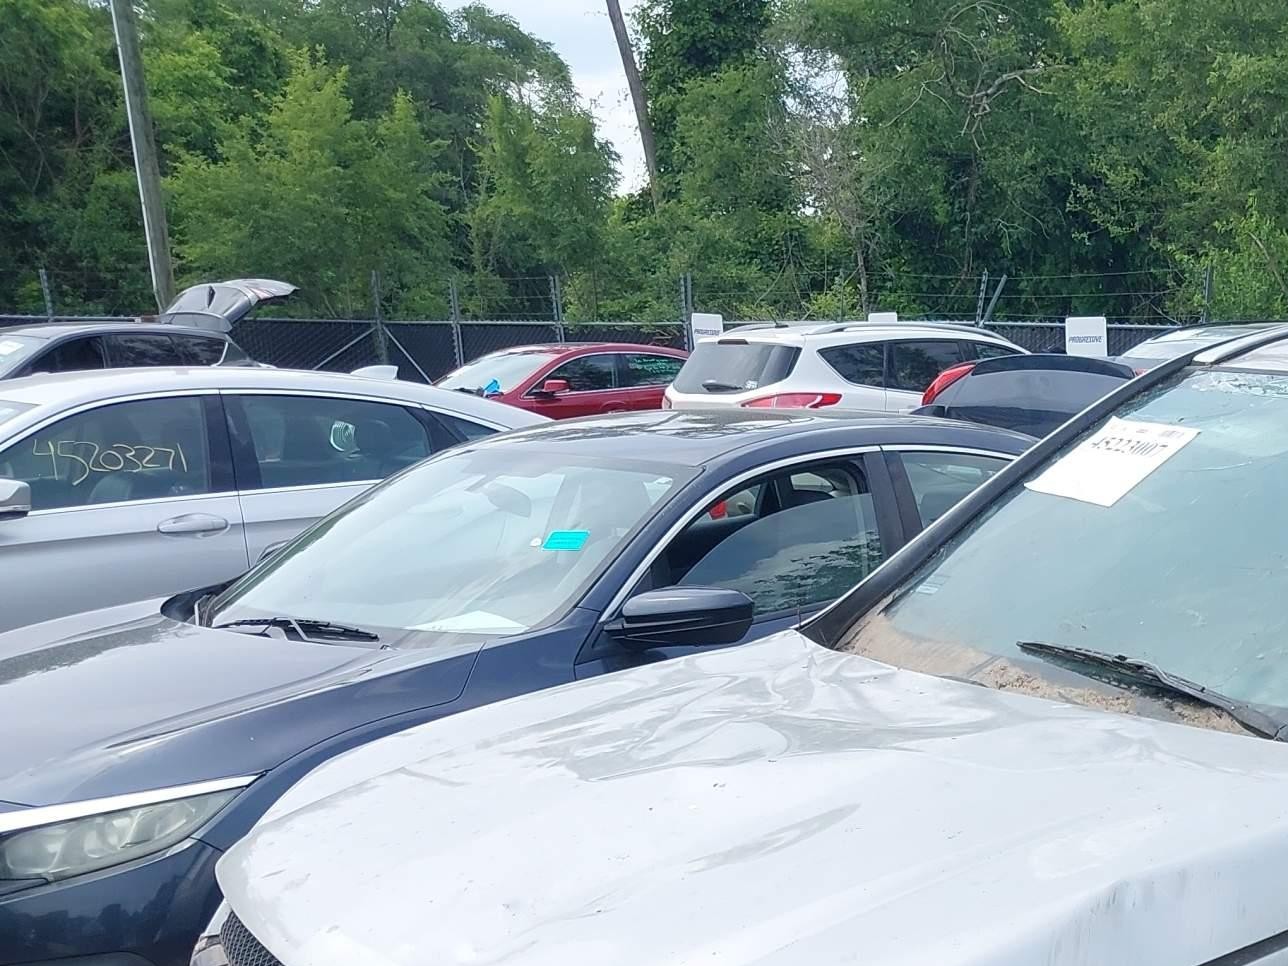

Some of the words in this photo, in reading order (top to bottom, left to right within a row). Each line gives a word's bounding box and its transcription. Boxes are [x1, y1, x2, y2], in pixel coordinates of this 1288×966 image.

[1069, 335, 1102, 343] PROGRESSIVE
[1091, 436, 1170, 457] 45223007
[32, 439, 188, 486] 45203271
